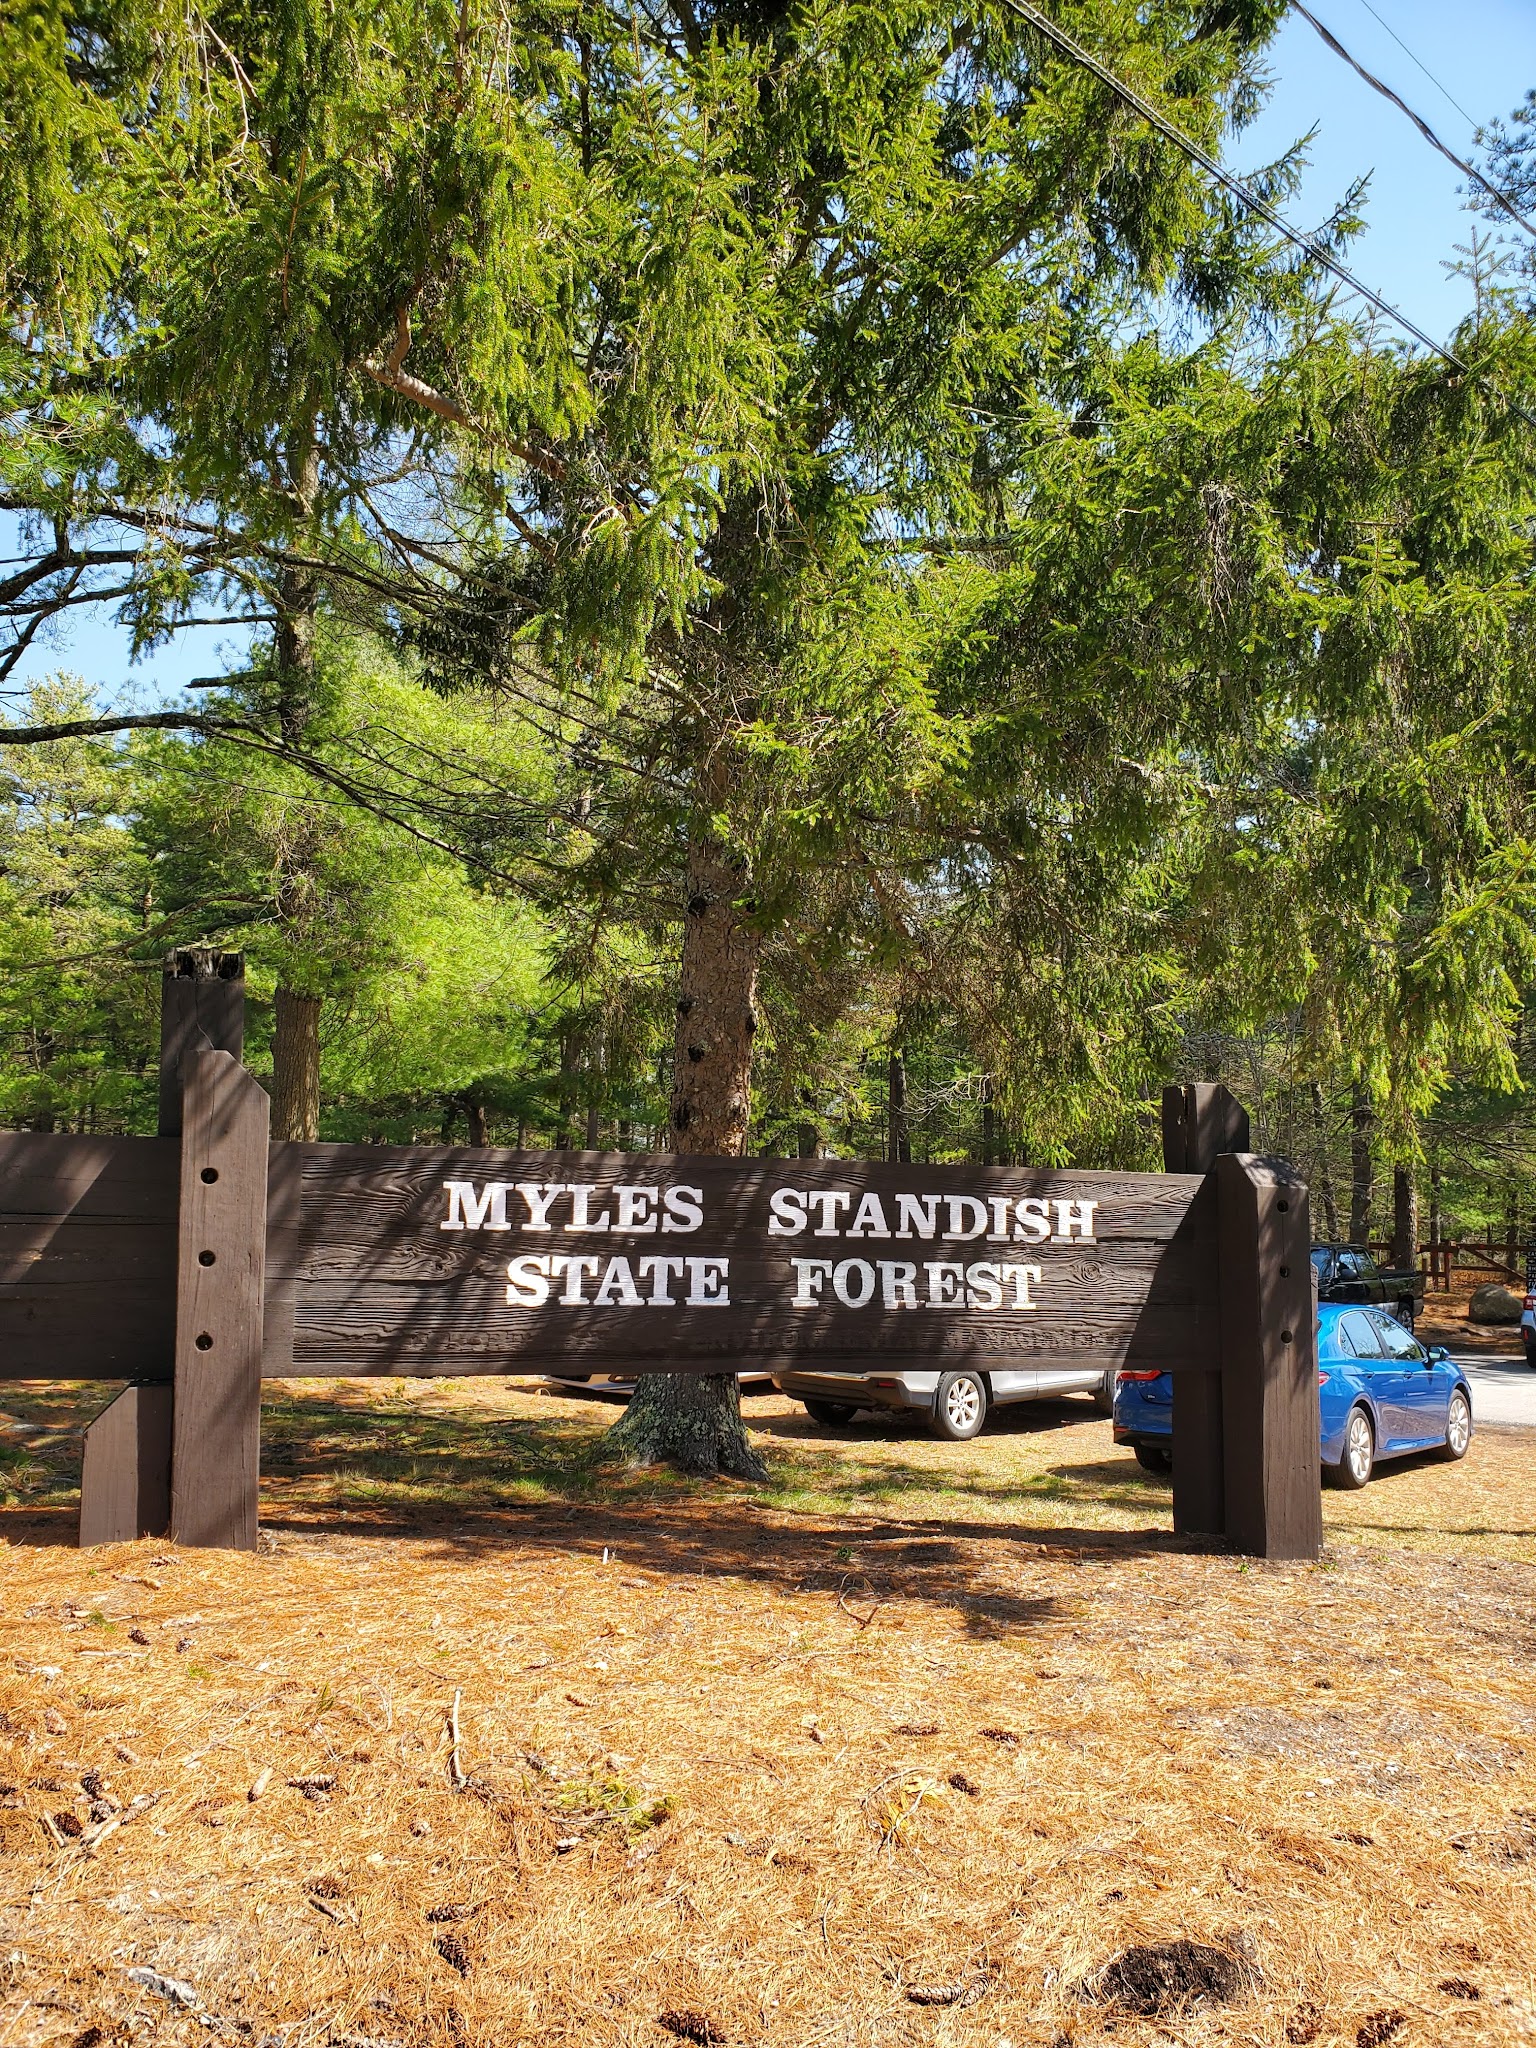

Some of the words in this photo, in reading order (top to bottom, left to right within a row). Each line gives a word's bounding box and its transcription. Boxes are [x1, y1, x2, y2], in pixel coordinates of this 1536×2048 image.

[441, 1181, 704, 1234] MYLES
[768, 1188, 1098, 1245] STANDISH
[505, 1255, 731, 1308] STATE
[791, 1258, 1042, 1311] FOREST
